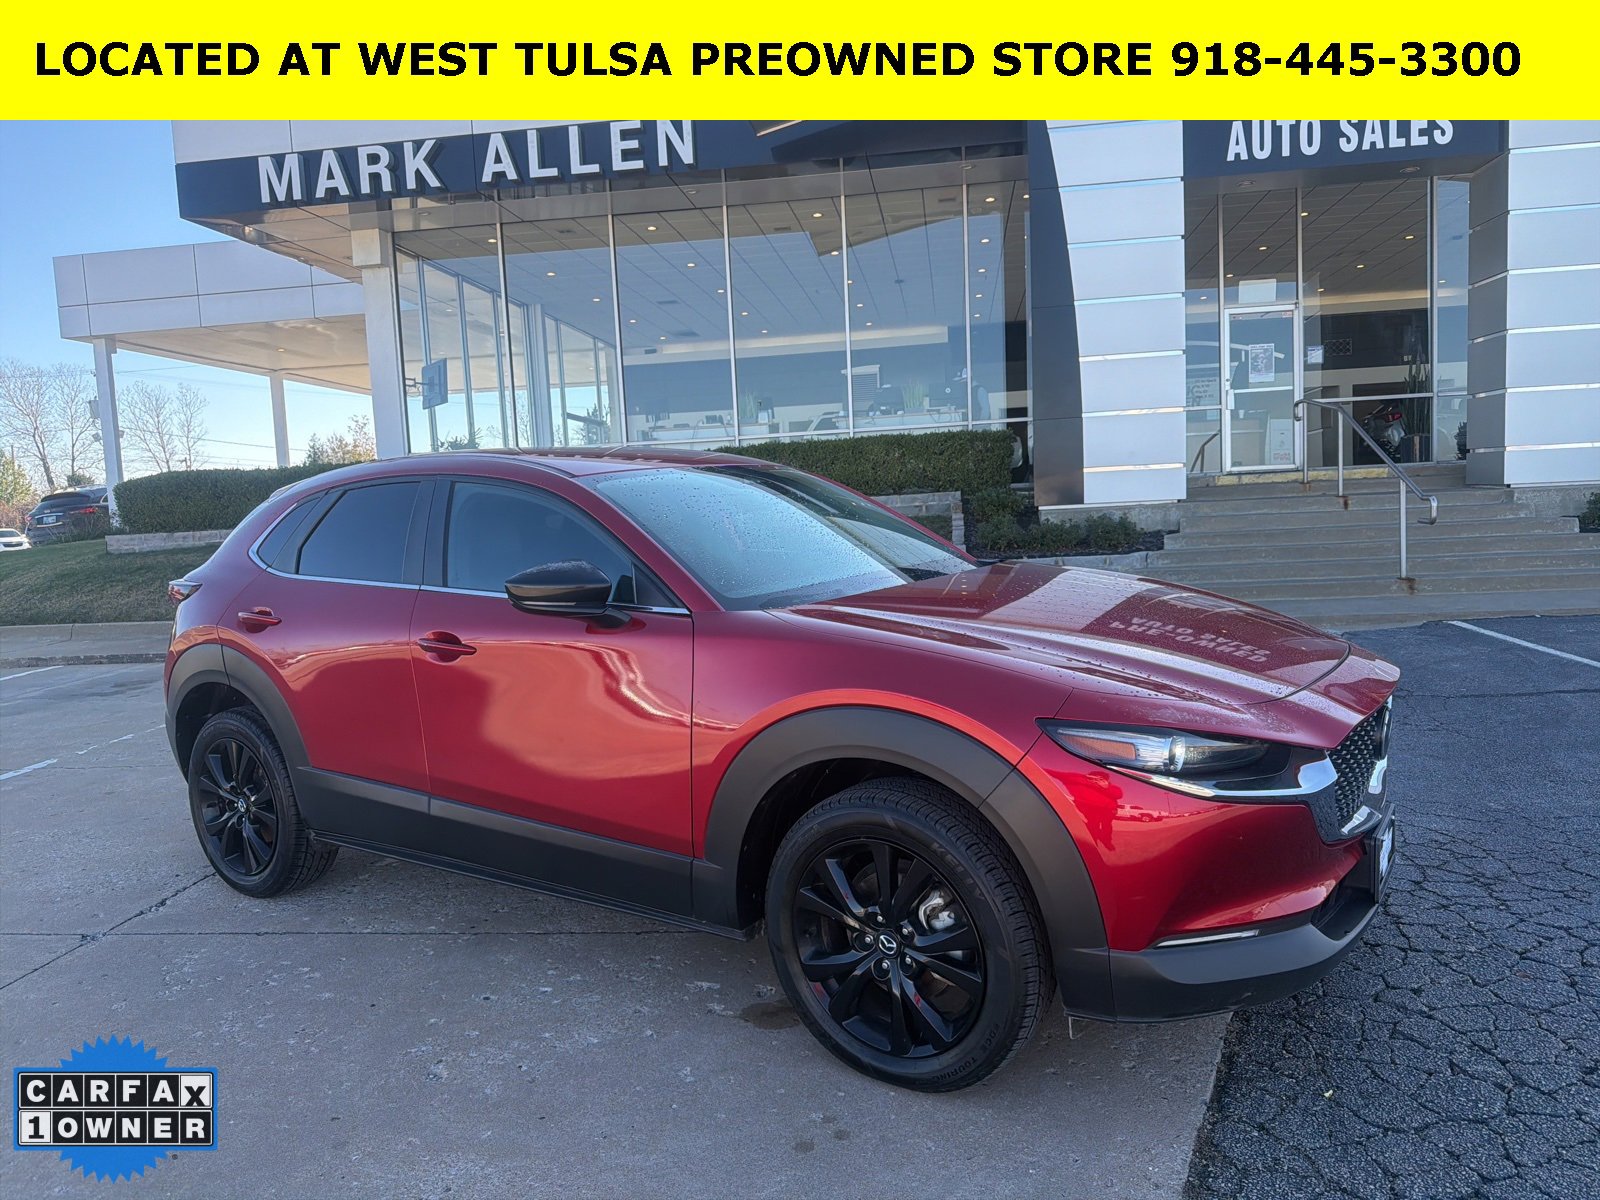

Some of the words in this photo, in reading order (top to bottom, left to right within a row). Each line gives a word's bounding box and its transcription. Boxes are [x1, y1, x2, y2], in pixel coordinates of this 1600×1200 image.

[258, 138, 444, 204] MARK
[481, 120, 697, 184] ALLEN
[1226, 120, 1322, 162] AUTO
[1338, 120, 1455, 153] SALES
